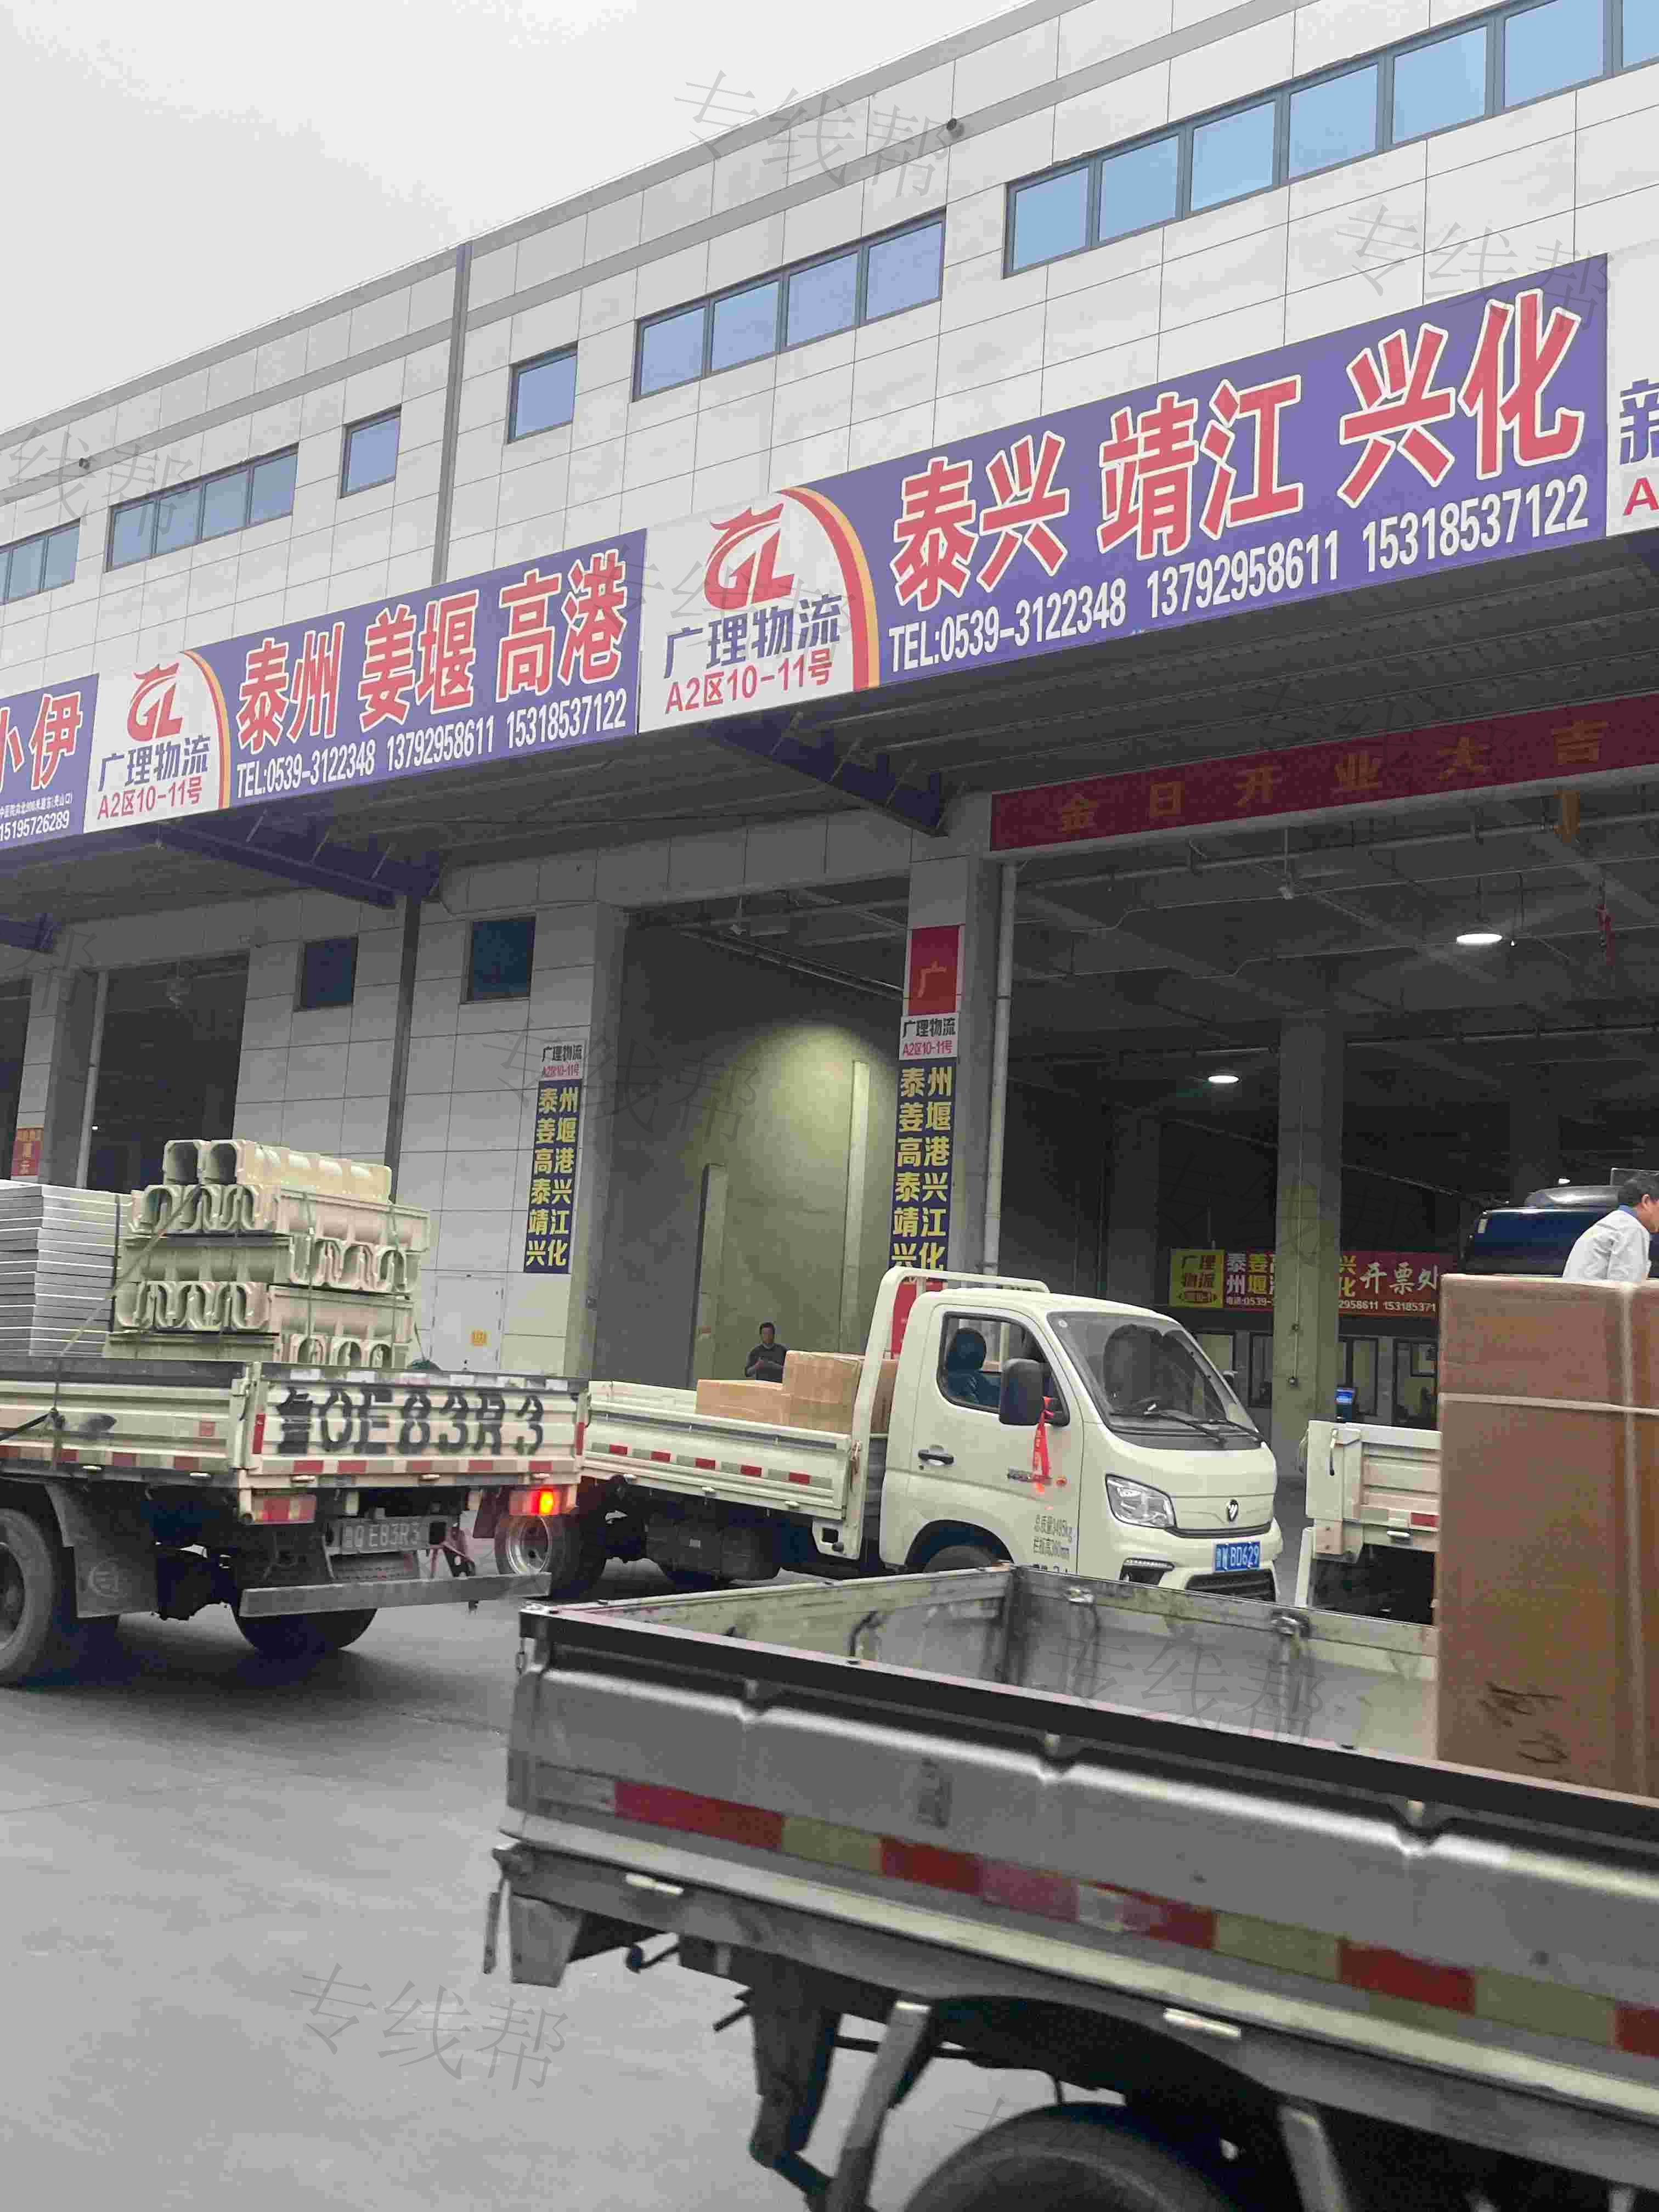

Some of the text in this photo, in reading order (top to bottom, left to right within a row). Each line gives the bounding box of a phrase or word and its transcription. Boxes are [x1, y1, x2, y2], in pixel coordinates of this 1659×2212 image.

[890, 431, 1070, 612] 泰兴
[1097, 375, 1302, 561] 靖江
[1337, 289, 1584, 508] 兴化
[889, 475, 1588, 672] TEL:0539-3122348 13792958611 15318537122
[236, 549, 628, 753] 泰州 姜堰 高港
[664, 593, 842, 678] 广理物流
[664, 648, 832, 714] A2区10-11号
[236, 687, 626, 799] TEL:0539-3122348 13792958611 15318537122
[97, 735, 211, 792] 广理物流
[97, 776, 202, 819] A2区10-11号
[902, 1018, 956, 1037] 广理物流
[542, 1044, 582, 1062] 广理物流
[900, 1066, 953, 1097] 泰州
[539, 1087, 578, 1114] 泰州
[537, 1118, 577, 1143] 姜堰
[898, 1102, 952, 1133] 姜堰
[534, 1148, 574, 1173] 高港
[896, 1137, 950, 1168] 高港
[532, 1178, 572, 1204] 泰兴
[895, 1172, 949, 1203] 泰兴
[528, 1209, 570, 1235] 靖江
[893, 1207, 946, 1237] 靖江
[526, 1239, 568, 1266] 兴化
[891, 1242, 945, 1271] 兴化
[1359, 1261, 1438, 1295] 开票处
